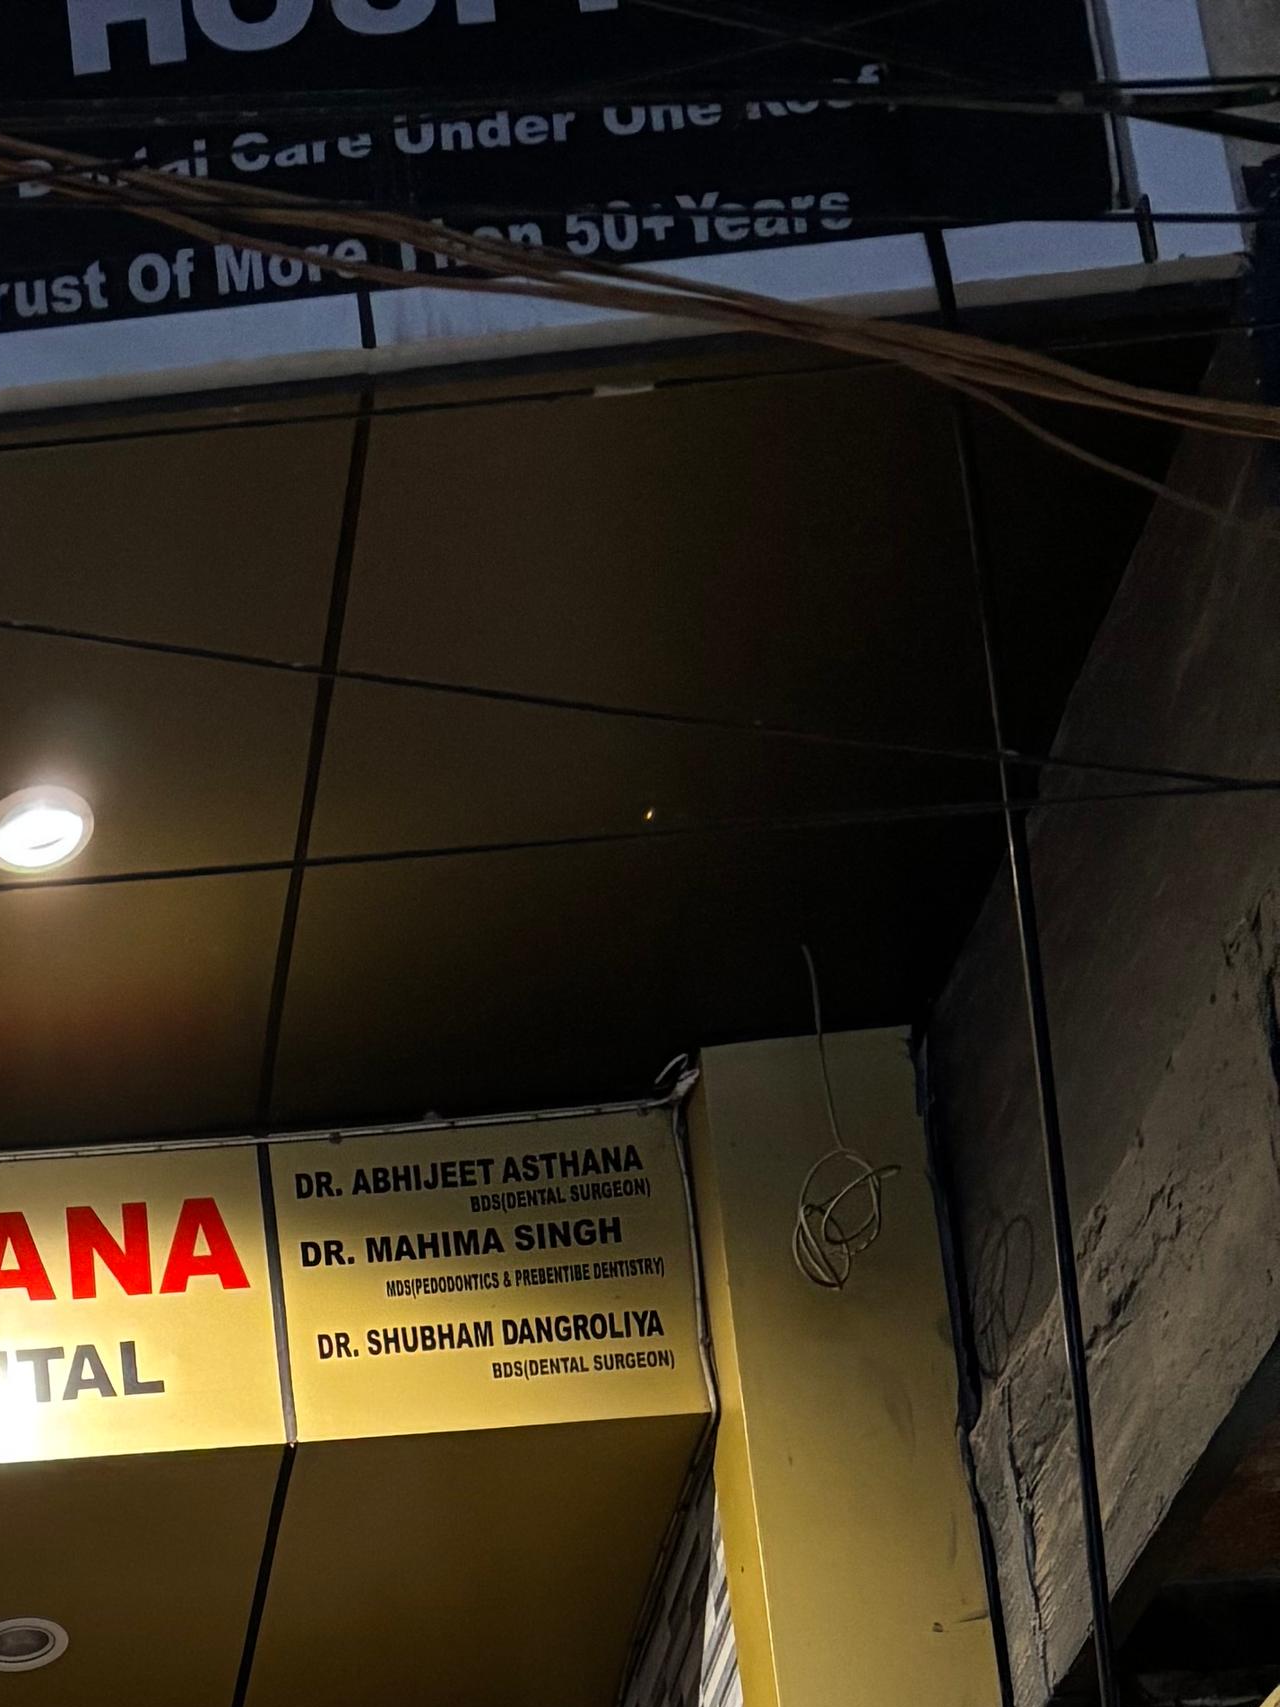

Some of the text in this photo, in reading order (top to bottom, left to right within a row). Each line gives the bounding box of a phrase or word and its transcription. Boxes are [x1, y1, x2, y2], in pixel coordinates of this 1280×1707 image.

[231, 132, 371, 172] Care
[394, 111, 575, 154] Under
[129, 248, 194, 303] Of
[214, 238, 367, 295] More
[296, 1145, 643, 1199] DR. ABHIJEET ASTHANA
[571, 1178, 650, 1202] SURGEON)
[301, 1217, 622, 1267] DR. MAHIMA SINGH
[318, 1310, 664, 1360] DR. SHUBHAM DANGROLIYA
[593, 1350, 675, 1371] SURGEON)
